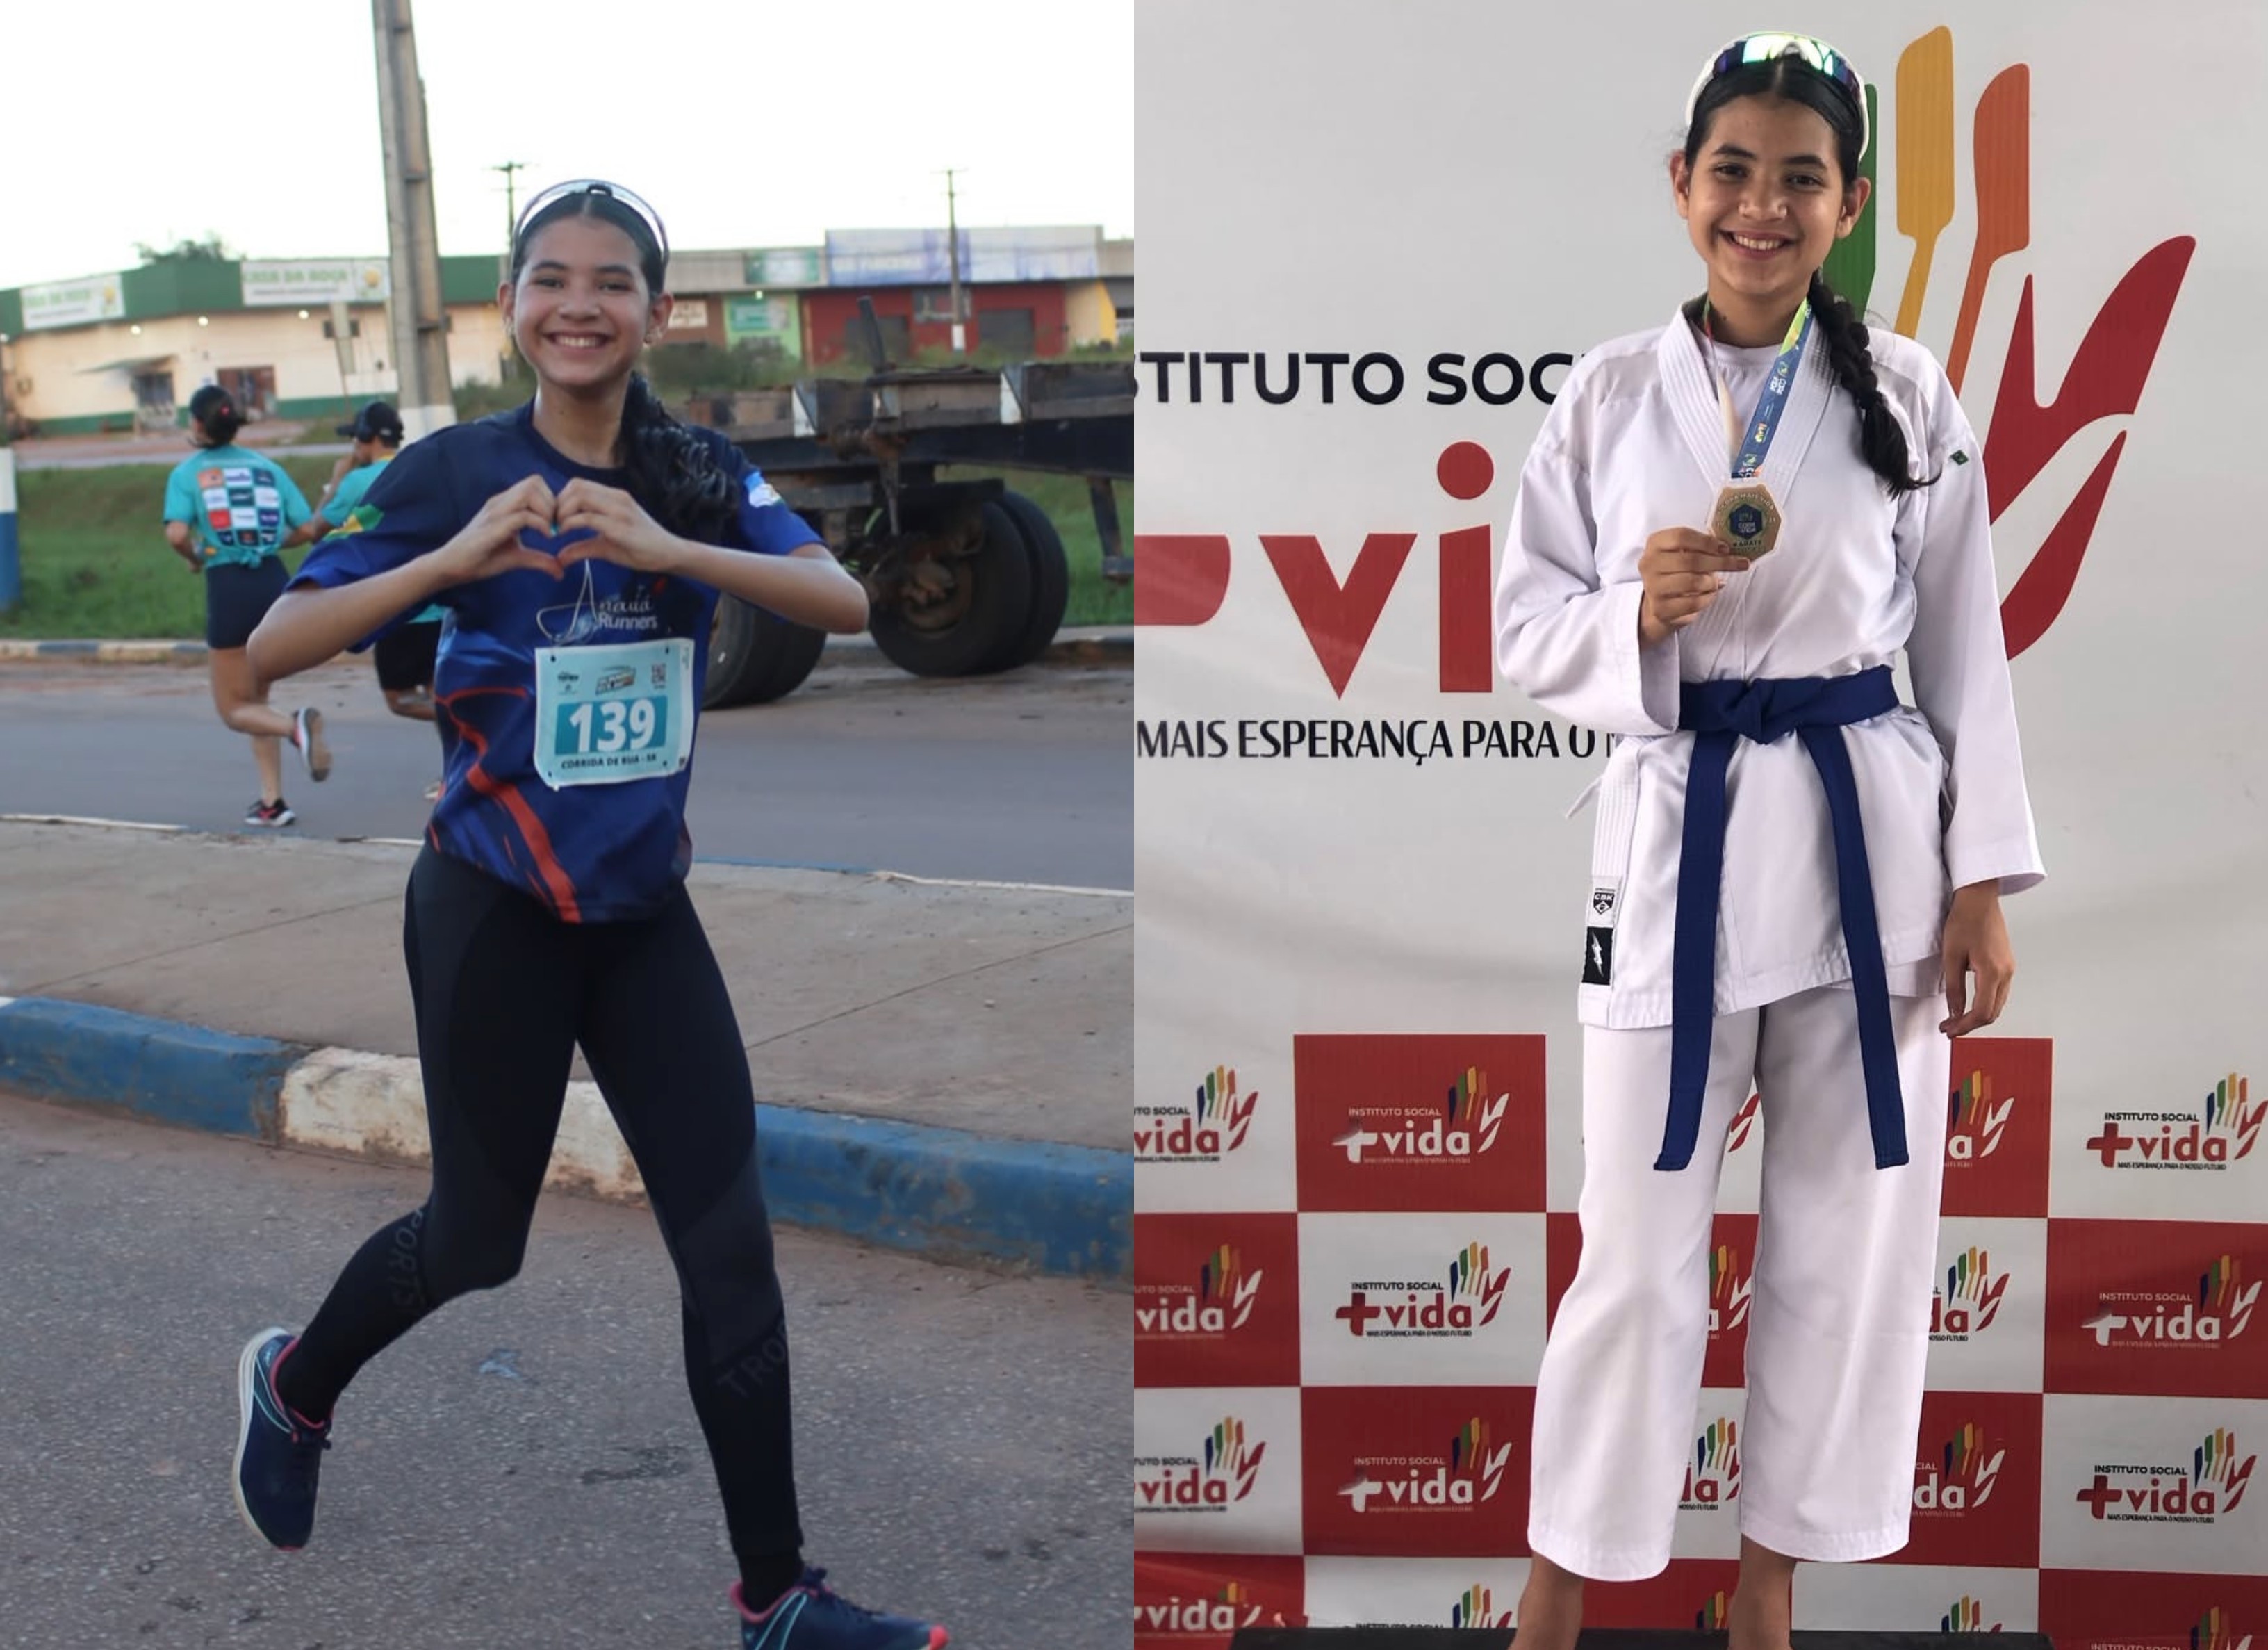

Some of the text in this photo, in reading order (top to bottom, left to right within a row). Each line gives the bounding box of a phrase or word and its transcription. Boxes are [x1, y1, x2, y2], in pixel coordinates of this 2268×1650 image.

[1134, 352, 1585, 405] TITUTO SOC
[598, 612, 658, 630] Runners
[569, 699, 655, 753] 139
[1137, 721, 1229, 758] MAIS
[1238, 721, 1452, 765] ESPERANÇA
[1463, 721, 1559, 758] PARA
[1594, 893, 1613, 901] CBK
[1349, 1108, 1442, 1116] INSTITUTO SOCIAL
[2105, 1112, 2200, 1122] INSTITUTO SOCIAL
[1134, 1117, 1219, 1154] vida
[1351, 1282, 1444, 1291] INSTITUTO SOCIAL
[2098, 1293, 2193, 1302] INSTITUTO SOCIAL
[1135, 1295, 1224, 1332] vida
[1354, 1457, 1446, 1465] INSTITUTO SOCIAL
[2094, 1464, 2188, 1476] INSTITUTO SOCIAL
[1140, 1467, 1227, 1505] vida
[1146, 1596, 1235, 1631] vida
